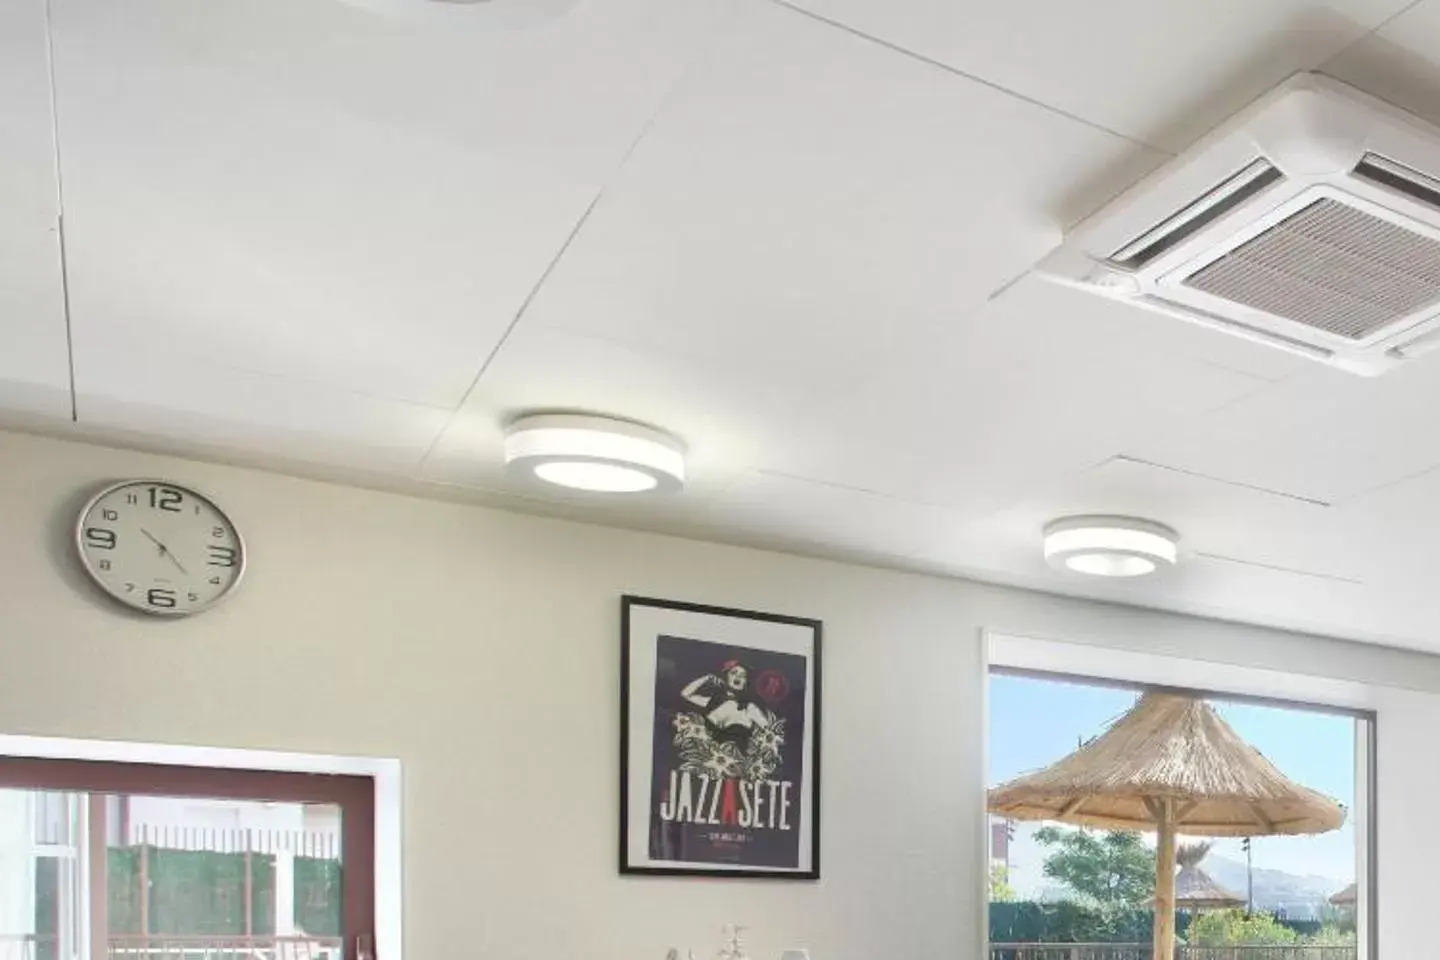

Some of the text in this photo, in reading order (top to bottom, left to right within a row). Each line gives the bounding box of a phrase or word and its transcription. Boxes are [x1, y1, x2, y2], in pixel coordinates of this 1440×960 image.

[128, 494, 138, 506] 11
[148, 487, 184, 513] 12
[103, 509, 118, 521] 10
[86, 527, 117, 550] 9
[207, 545, 237, 567] 3
[125, 583, 135, 592] 7
[209, 576, 221, 586] 4
[148, 589, 176, 608] 6
